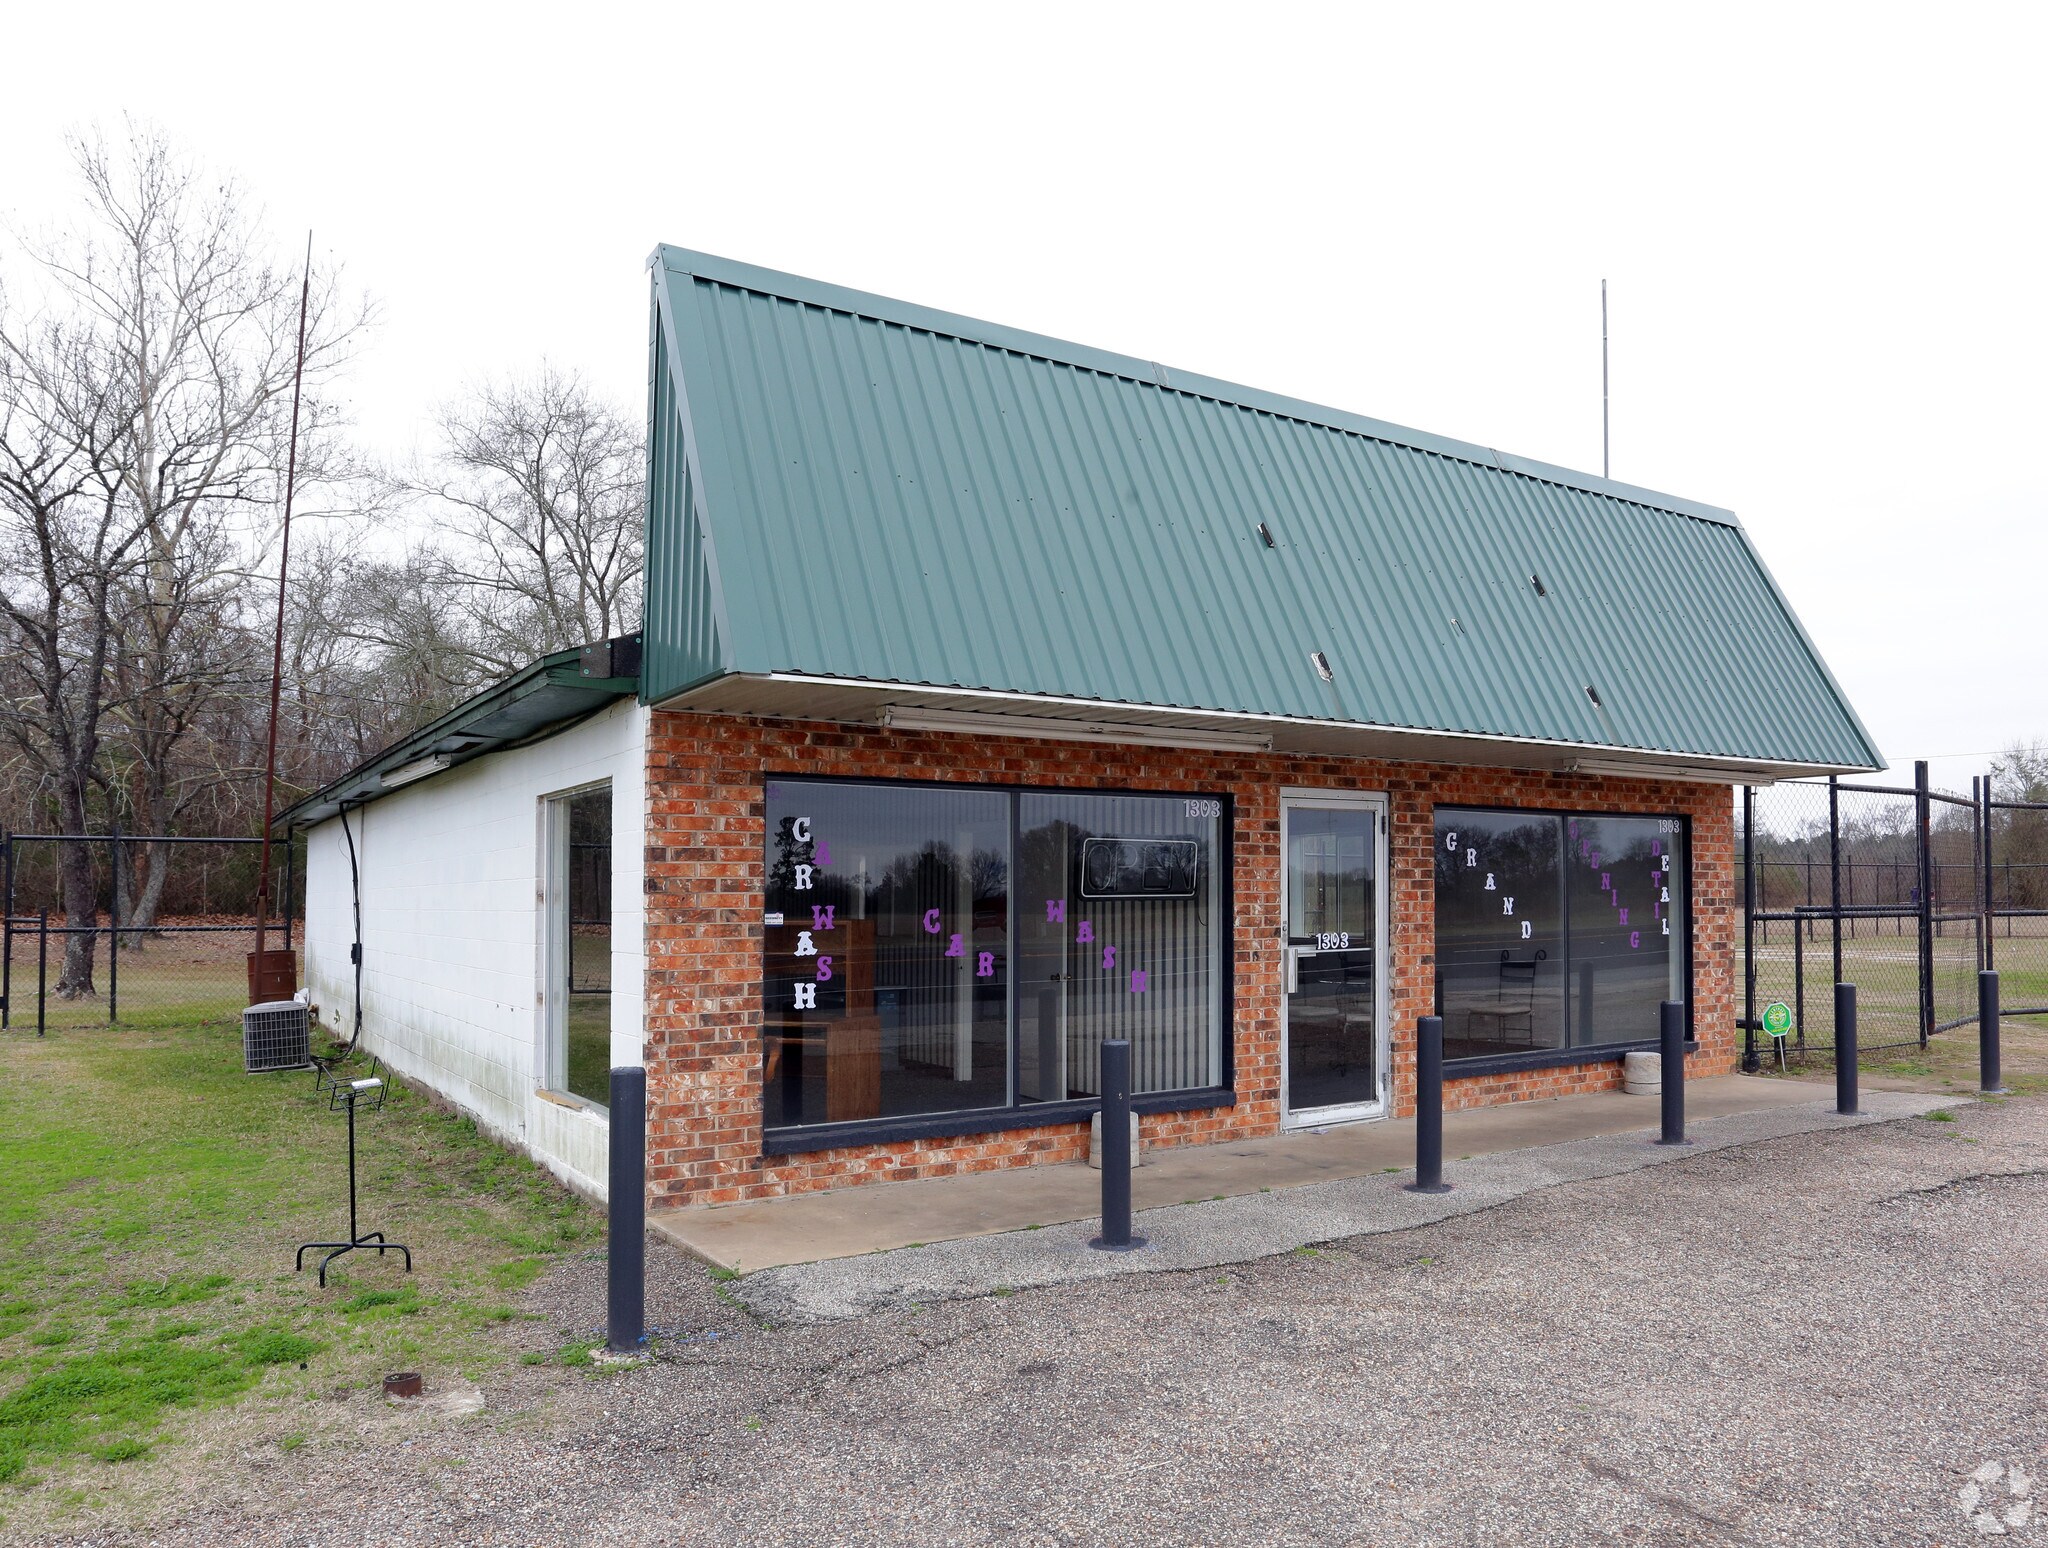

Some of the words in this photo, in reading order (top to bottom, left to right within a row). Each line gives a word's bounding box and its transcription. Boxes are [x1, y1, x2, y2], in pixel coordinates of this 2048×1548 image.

[1183, 800, 1221, 817] 1303
[1658, 819, 1680, 833] 1303
[792, 817, 832, 889] CAR
[1088, 843, 1194, 890] OPEN
[1446, 832, 1532, 939] GRAND
[1570, 821, 1640, 948] OPENING
[1652, 839, 1670, 935] DETAIL
[793, 905, 836, 1009] WASH
[923, 908, 995, 977] CAR
[1046, 900, 1147, 993] WASH
[1316, 932, 1348, 949] 1303
